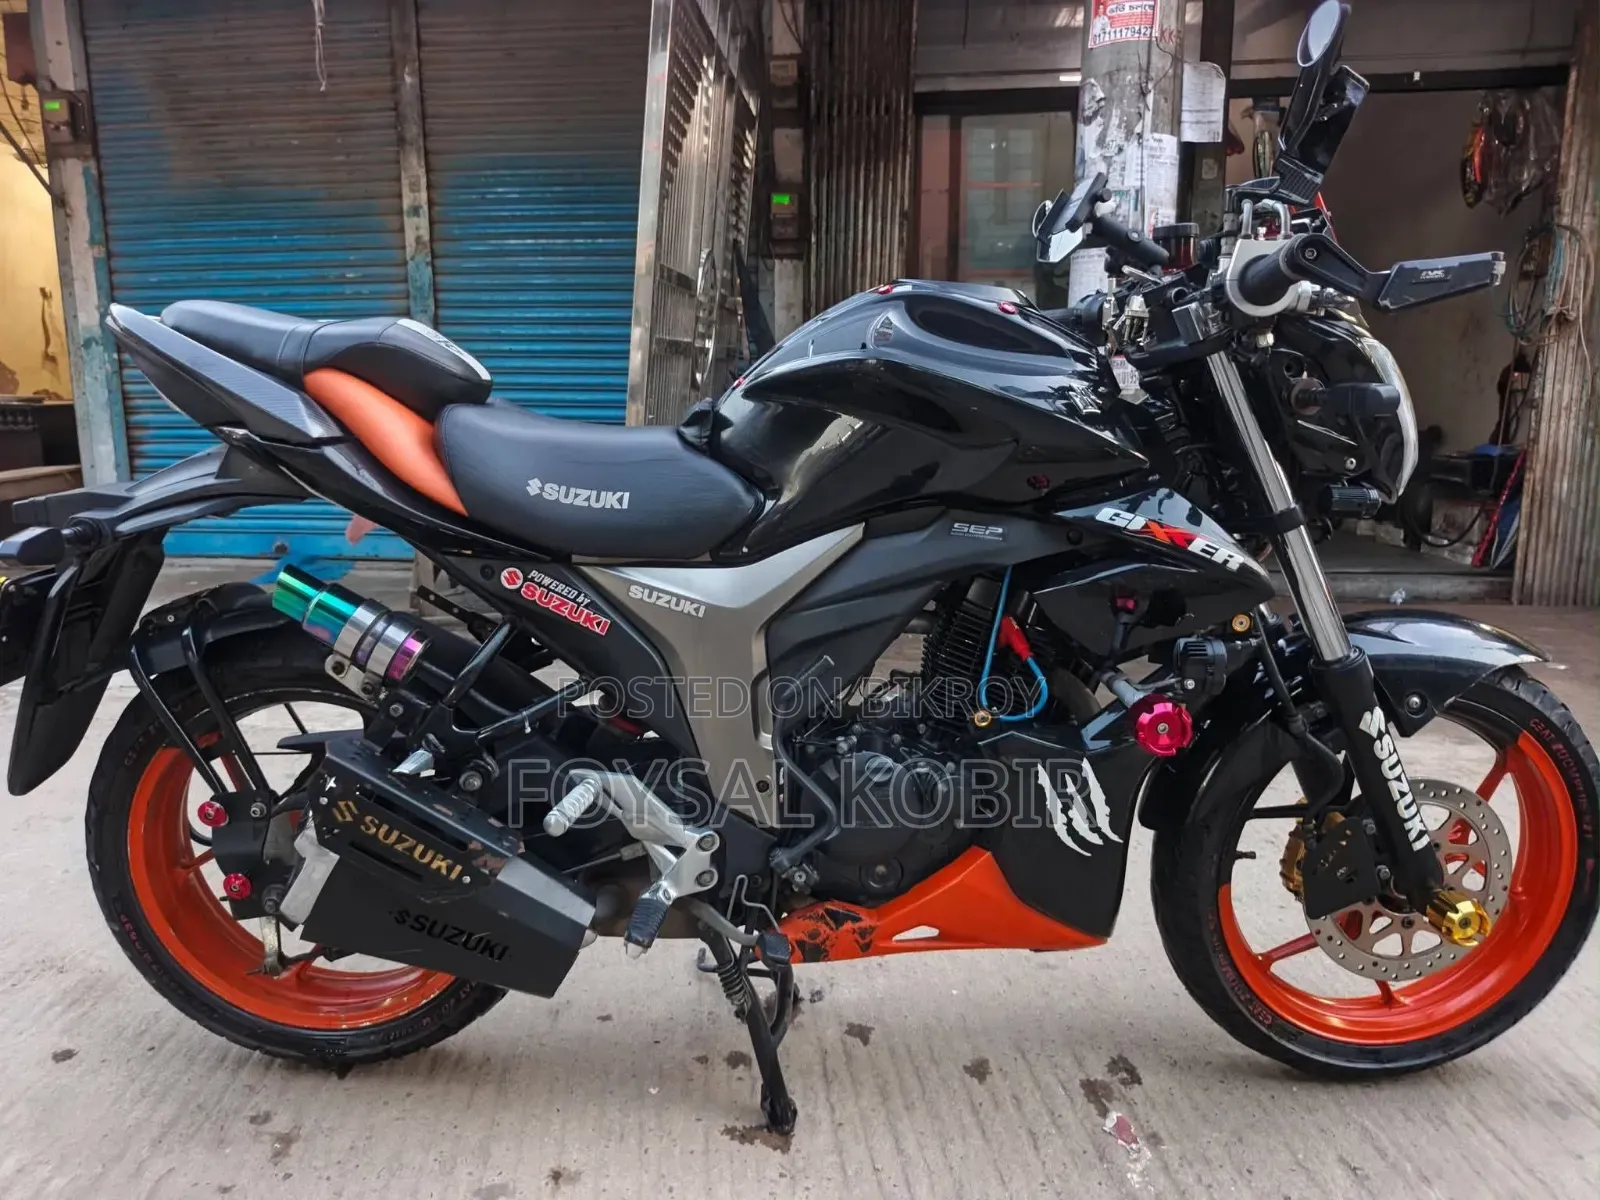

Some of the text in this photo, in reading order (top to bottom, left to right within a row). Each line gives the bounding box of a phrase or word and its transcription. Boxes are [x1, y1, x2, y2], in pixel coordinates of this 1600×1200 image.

[1093, 26, 1154, 45] 01711179427
[542, 482, 630, 510] SUZUKI
[952, 522, 1003, 535] SEP
[1095, 507, 1245, 572] GIXXER
[521, 581, 611, 636] SUZUKI
[527, 569, 591, 607] POWERED by
[628, 584, 706, 618] SUZUKI
[1373, 735, 1431, 852] SUZUKI
[360, 815, 464, 881] SUZUKI
[409, 914, 510, 962] SUZUKI
